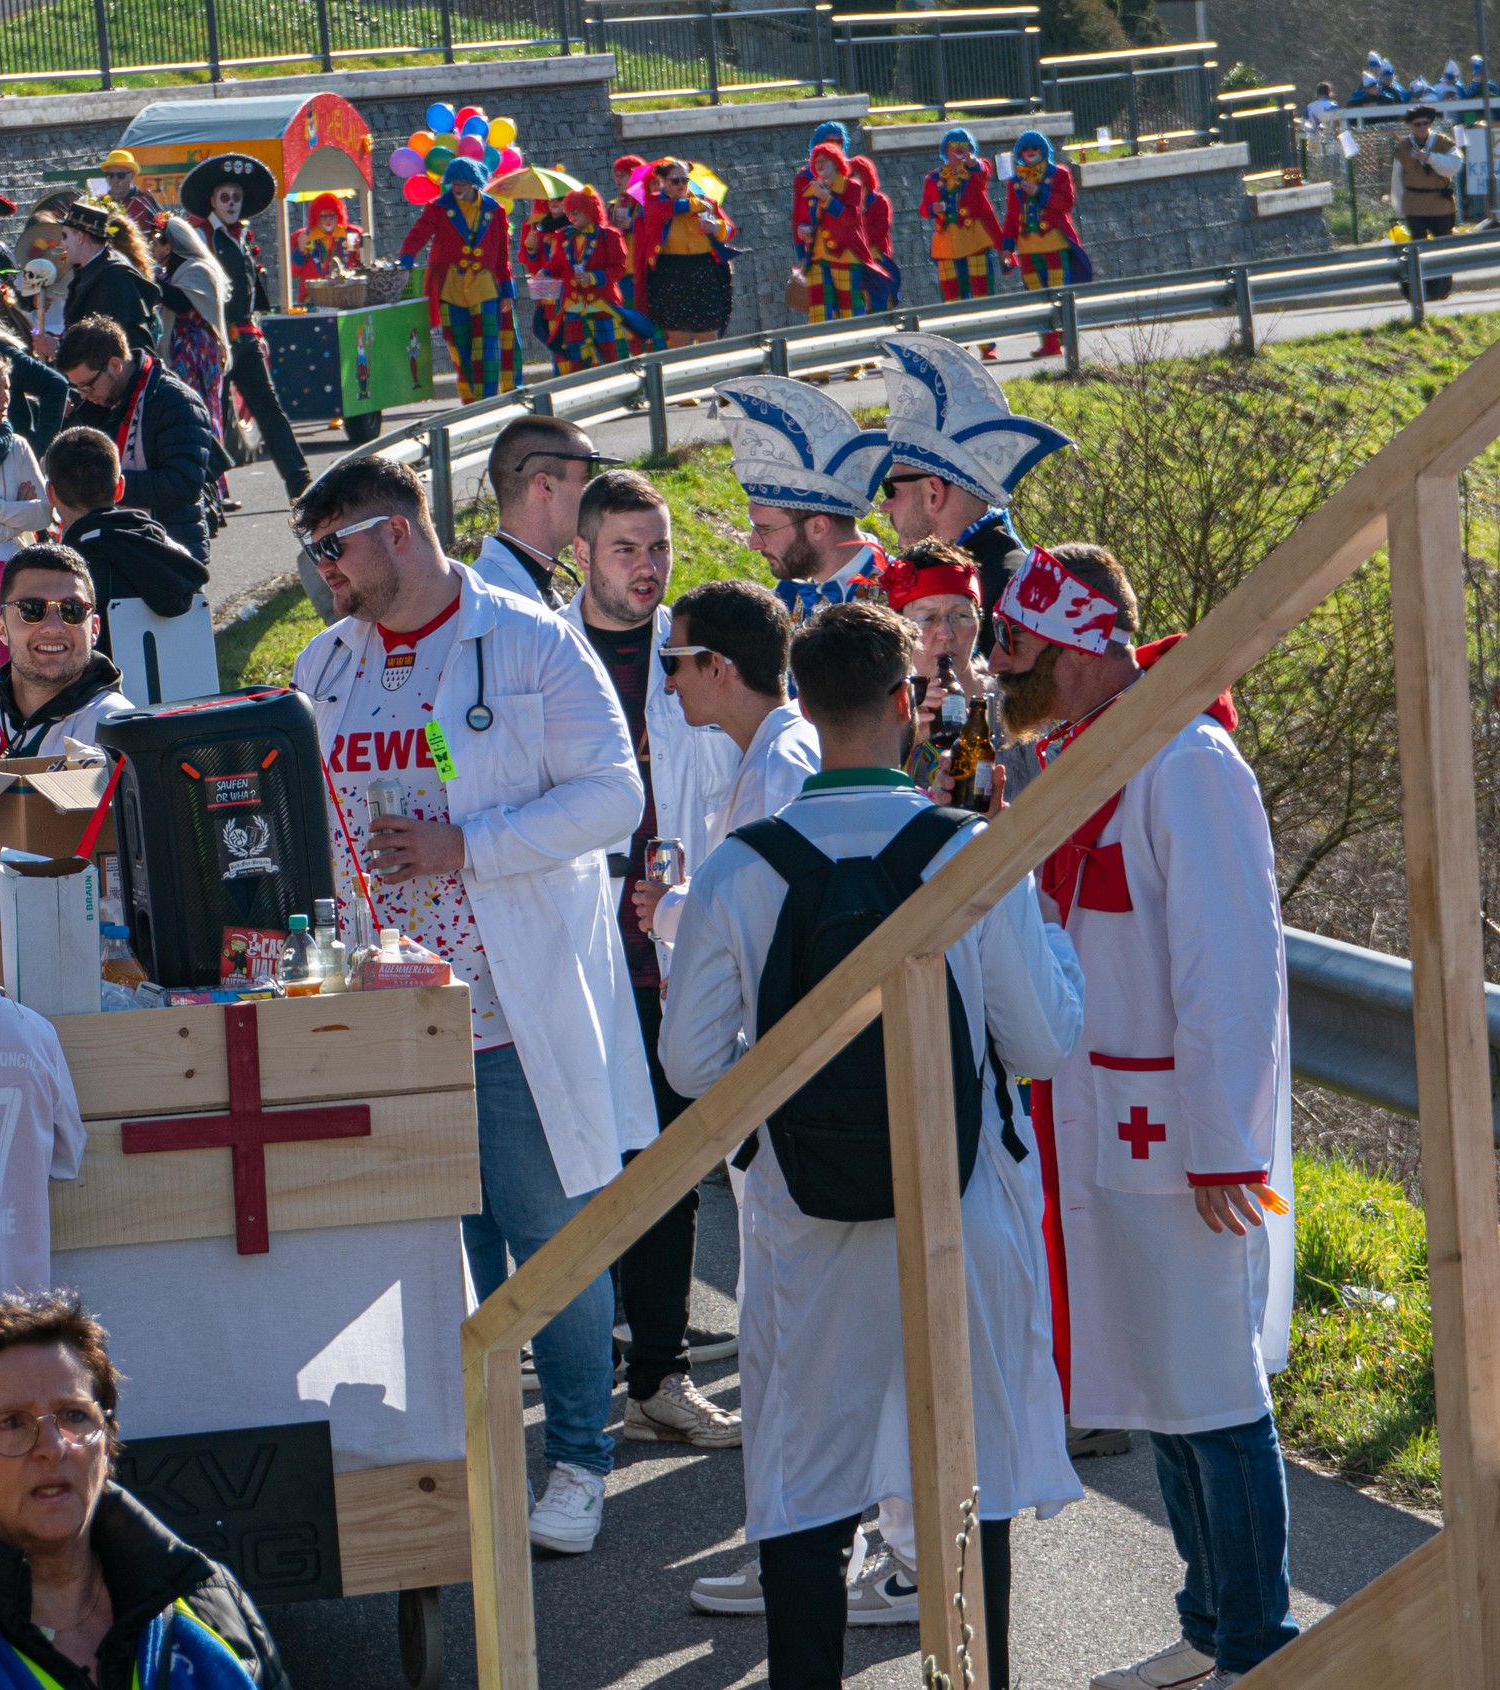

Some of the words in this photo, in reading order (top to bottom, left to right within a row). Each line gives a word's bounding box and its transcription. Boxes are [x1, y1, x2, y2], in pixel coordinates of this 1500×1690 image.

[329, 728, 436, 773] REWE
[216, 778, 248, 791] SAUFEN
[216, 793, 228, 803] OR
[85, 875, 93, 911] BRAUN
[379, 963, 436, 974] KUEMMERLING
